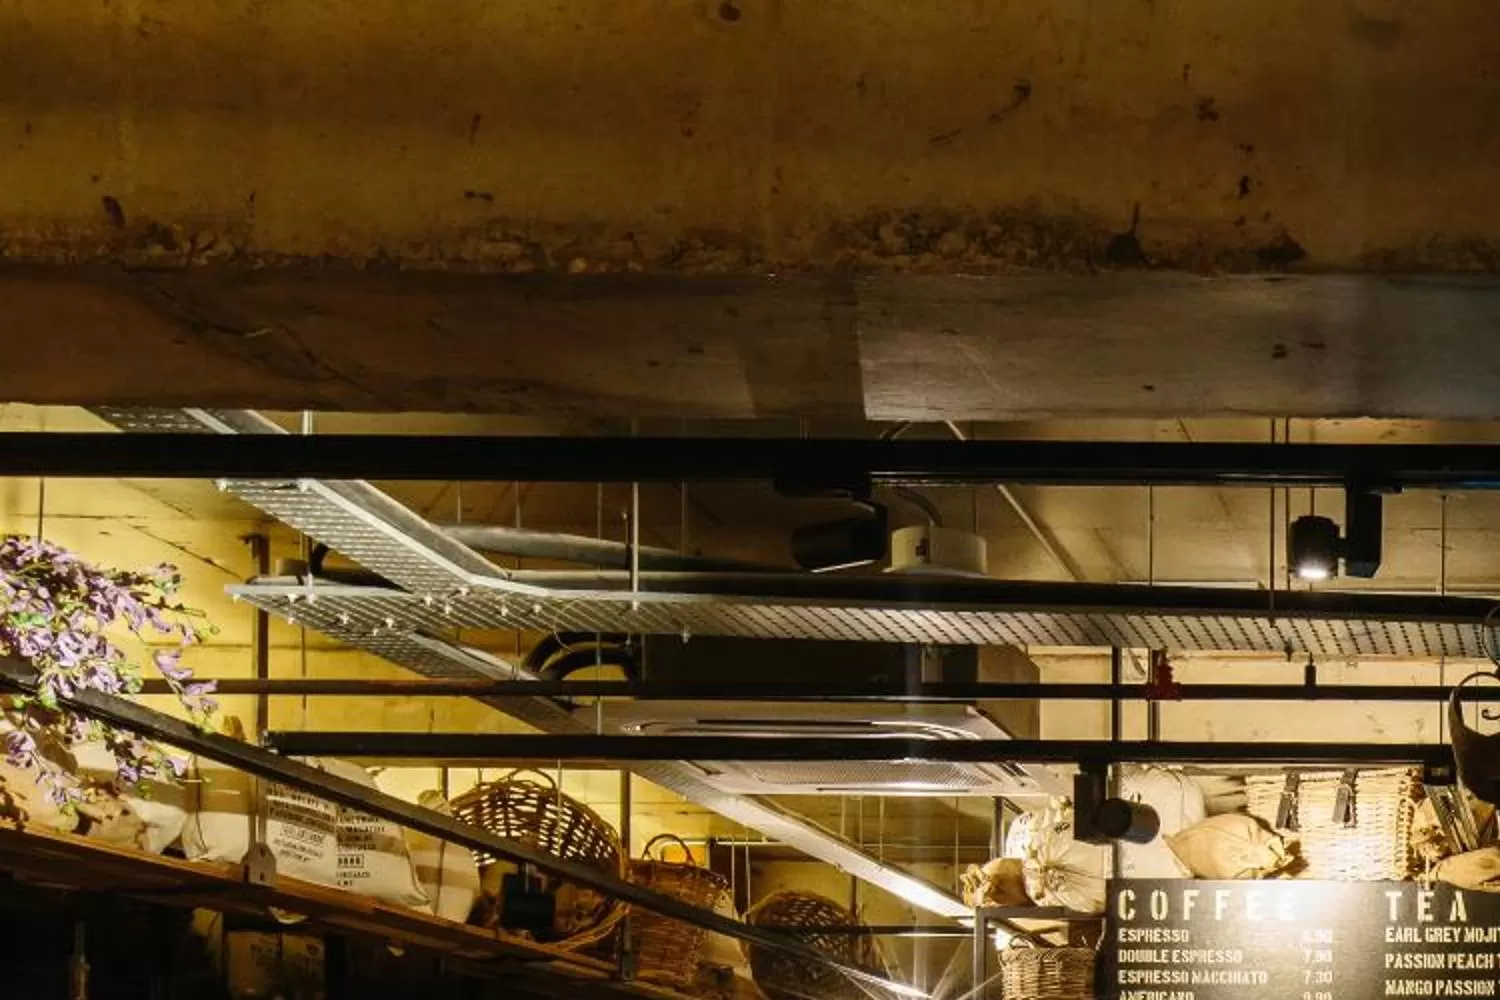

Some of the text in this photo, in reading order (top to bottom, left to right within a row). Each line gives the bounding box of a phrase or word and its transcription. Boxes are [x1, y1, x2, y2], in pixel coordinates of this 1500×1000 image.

[1118, 889, 1297, 921] COFFEE
[1385, 891, 1468, 922] TEA
[1118, 928, 1189, 942] ESPRESSO
[1385, 927, 1420, 943] EARL
[1425, 927, 1462, 943] GREY
[1118, 949, 1169, 963] DOUBLE
[1172, 949, 1243, 963] ESPRESSO
[1385, 953, 1445, 969] PASSION
[1448, 953, 1494, 969] PEACH
[1118, 970, 1333, 984] ESPRESSO MACCHIATO 7.30
[1385, 980, 1432, 996] MANGO
[1435, 980, 1495, 996] PASSION
